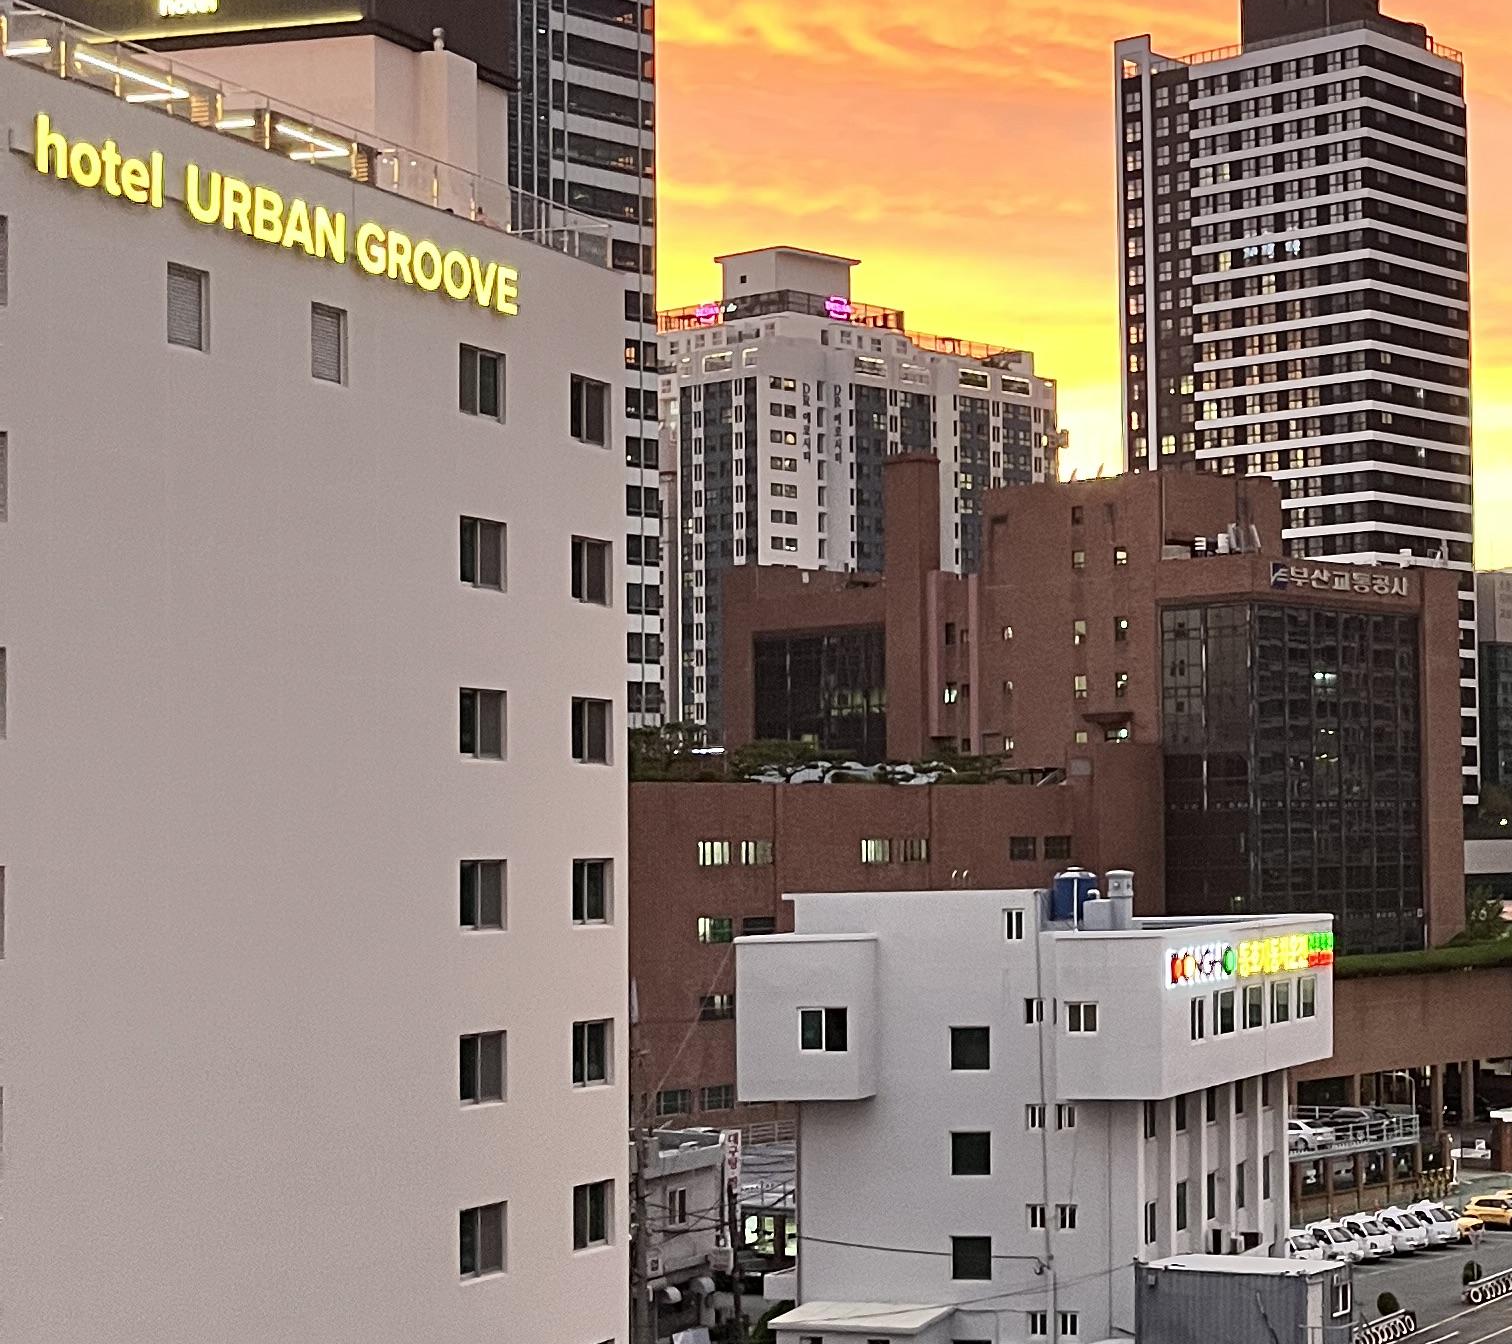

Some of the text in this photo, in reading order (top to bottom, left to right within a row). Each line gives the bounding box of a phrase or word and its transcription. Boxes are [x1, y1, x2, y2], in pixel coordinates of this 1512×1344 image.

[35, 112, 520, 316] hotel URBAN GROOVE
[1289, 565, 1408, 597] 부산교통공사
